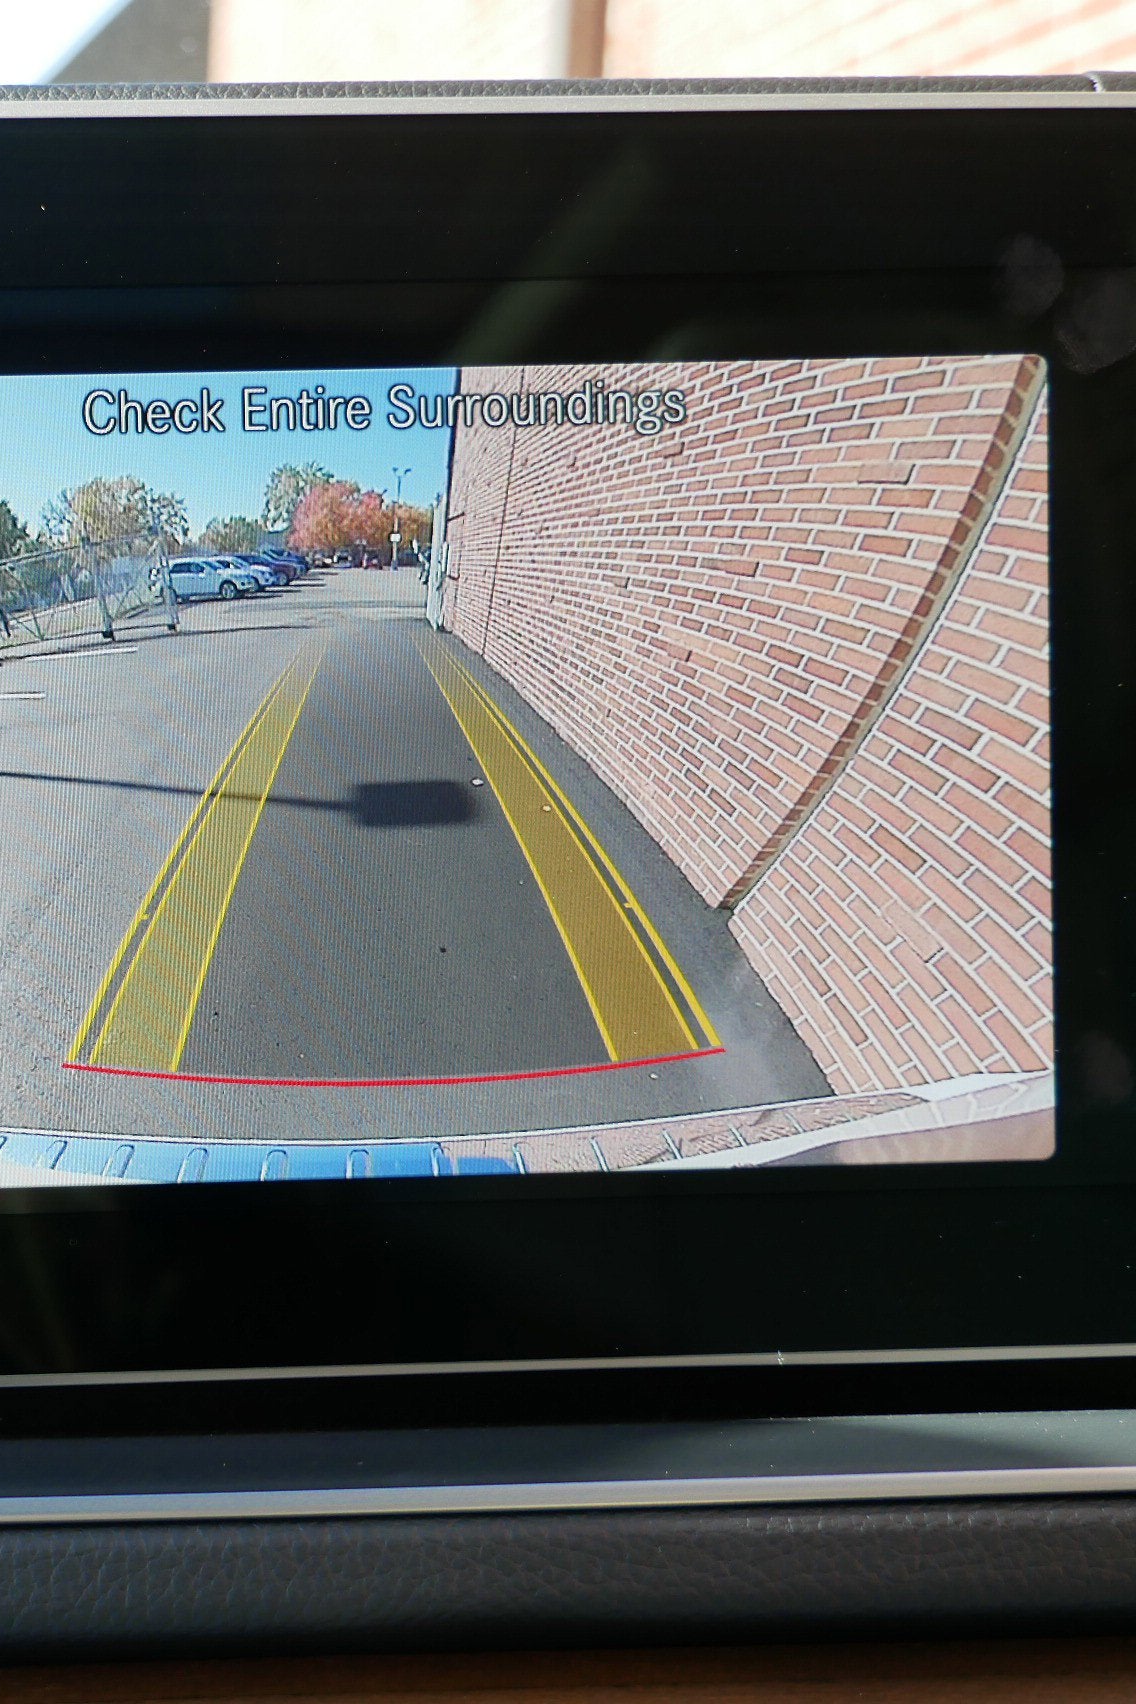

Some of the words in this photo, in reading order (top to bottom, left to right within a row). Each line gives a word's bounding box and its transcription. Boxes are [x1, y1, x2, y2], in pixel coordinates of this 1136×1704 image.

[82, 387, 227, 436] Check
[241, 385, 373, 433] Entire
[386, 379, 687, 436] Surroundings
